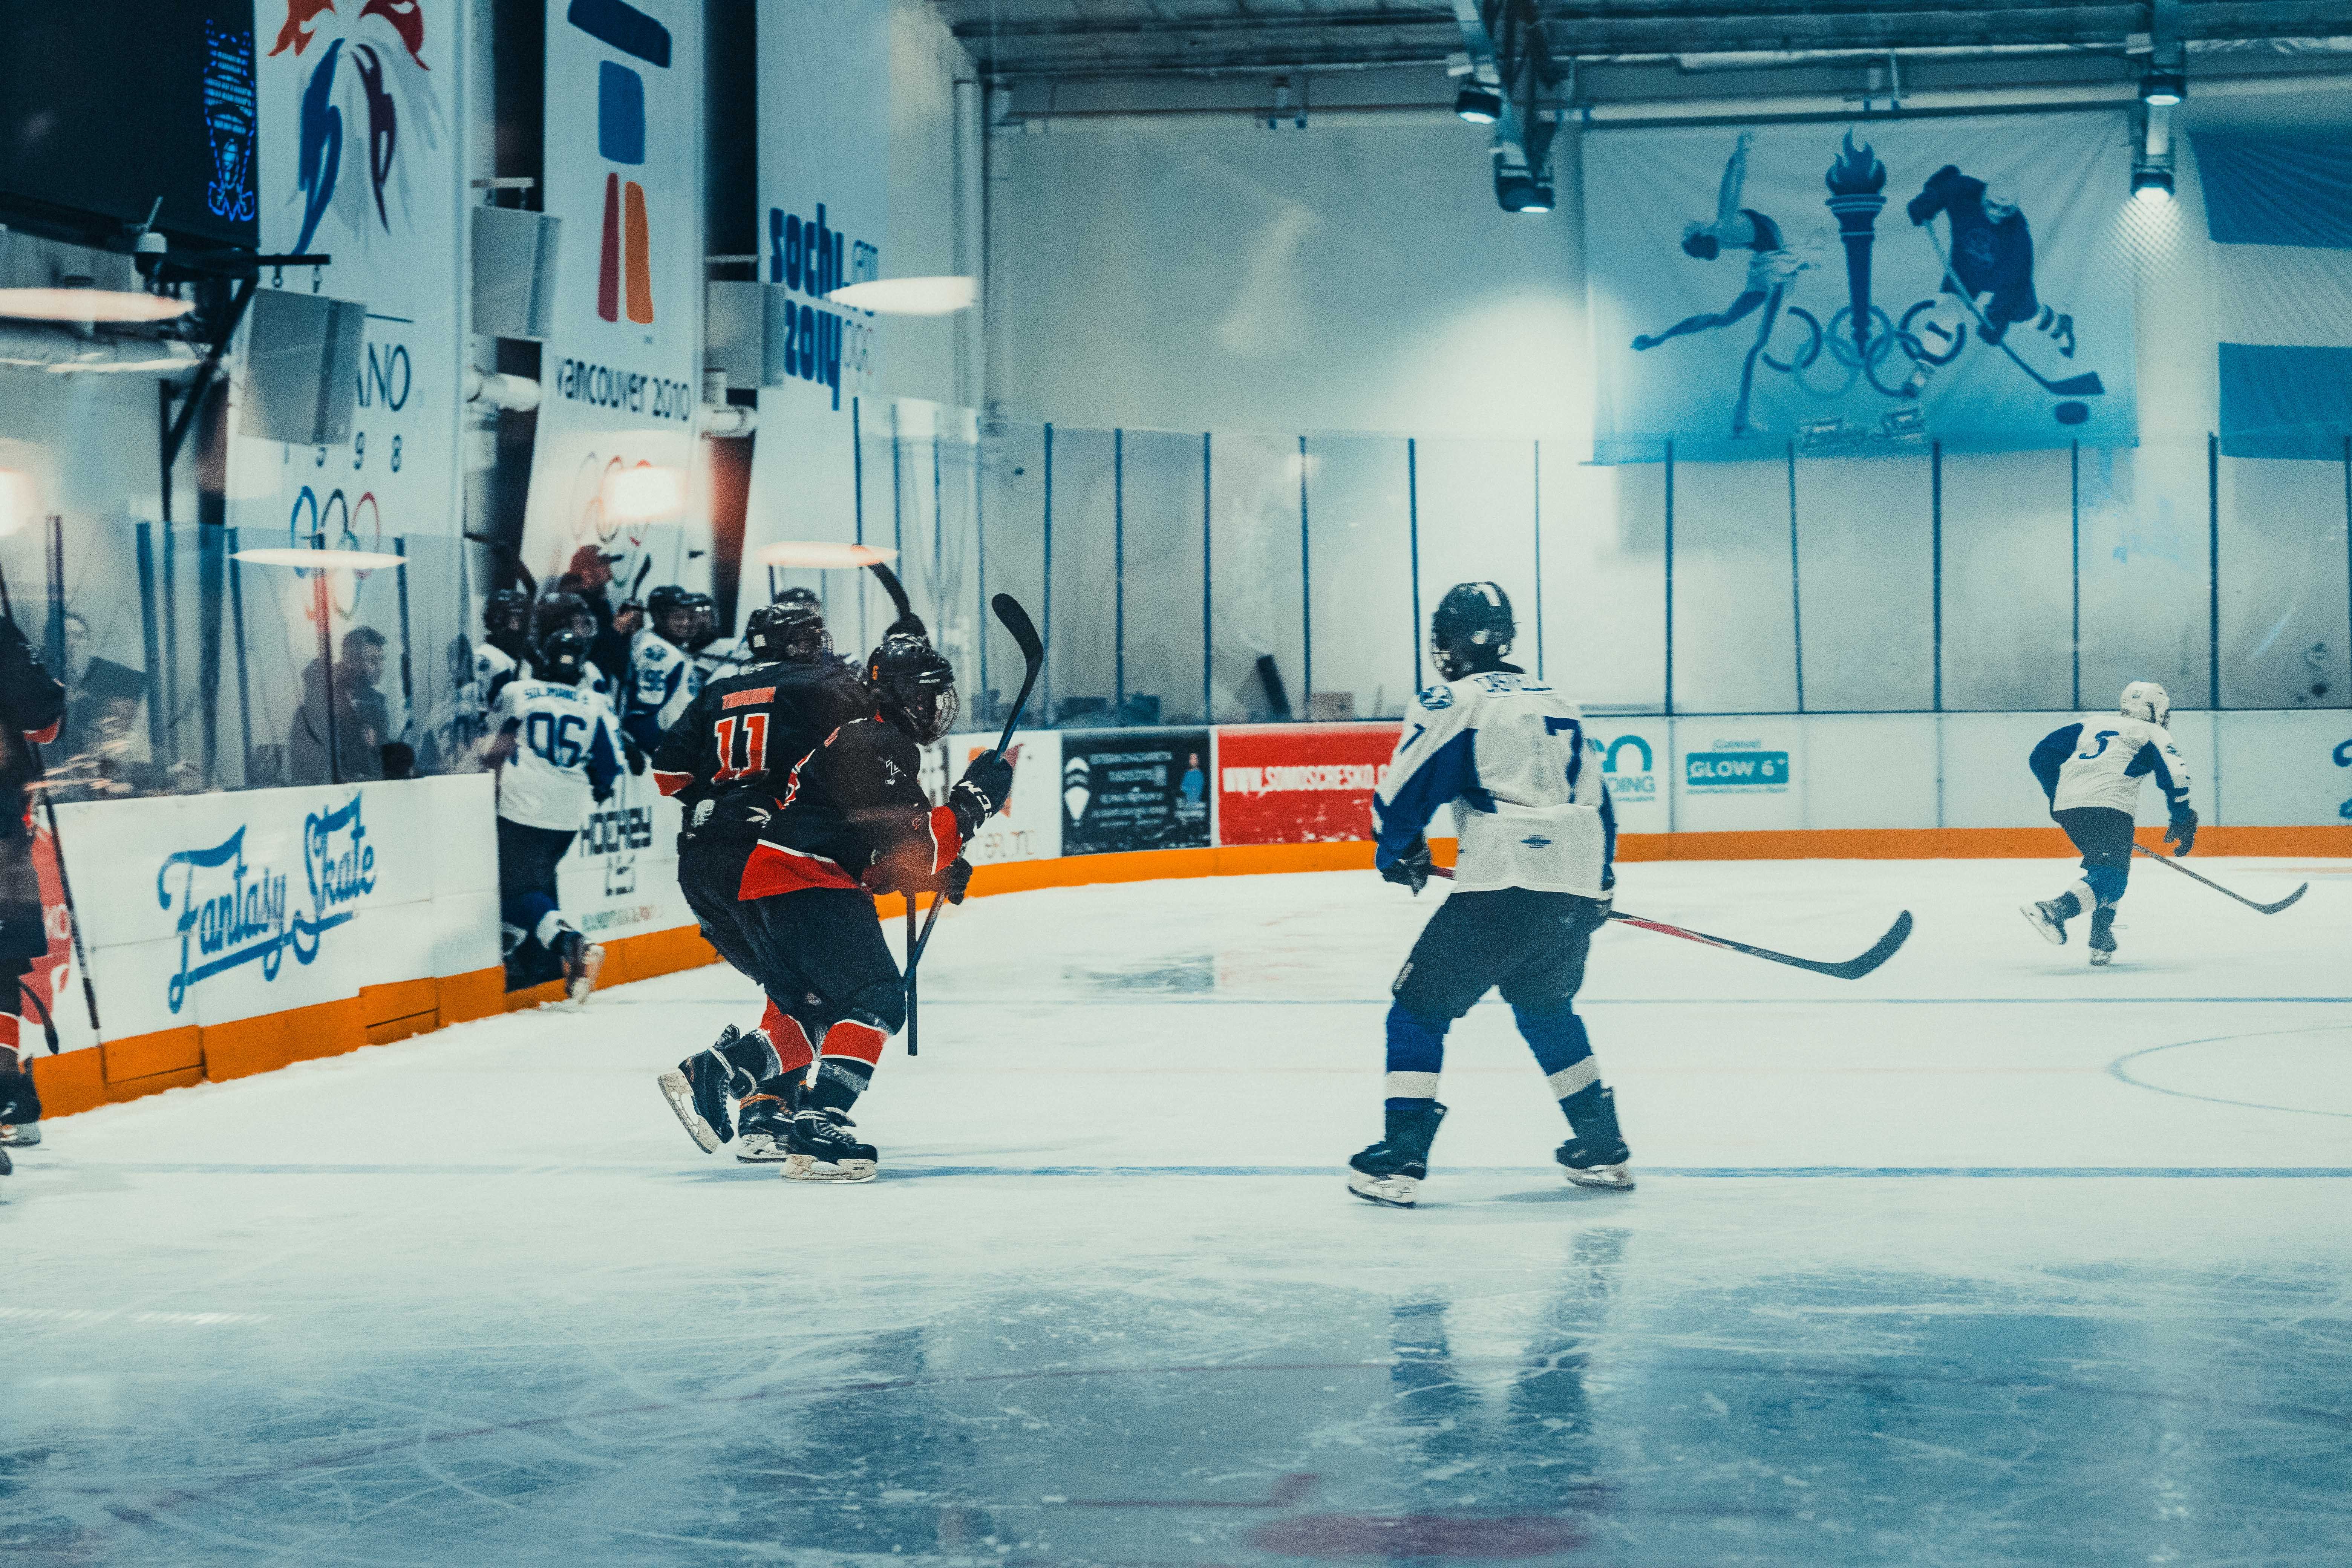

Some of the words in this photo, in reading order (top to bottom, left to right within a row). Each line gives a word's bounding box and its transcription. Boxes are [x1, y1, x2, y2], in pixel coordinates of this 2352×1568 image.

[357, 341, 412, 412] NO
[785, 299, 842, 411] 2014
[651, 376, 691, 422] 2010
[711, 713, 770, 784] 11
[1544, 715, 1582, 804] 7
[1689, 761, 1755, 778] GLOW
[1761, 760, 1775, 776] 6
[959, 780, 992, 819] CM
[157, 824, 286, 1014] Fantasy
[292, 790, 375, 965] Skate
